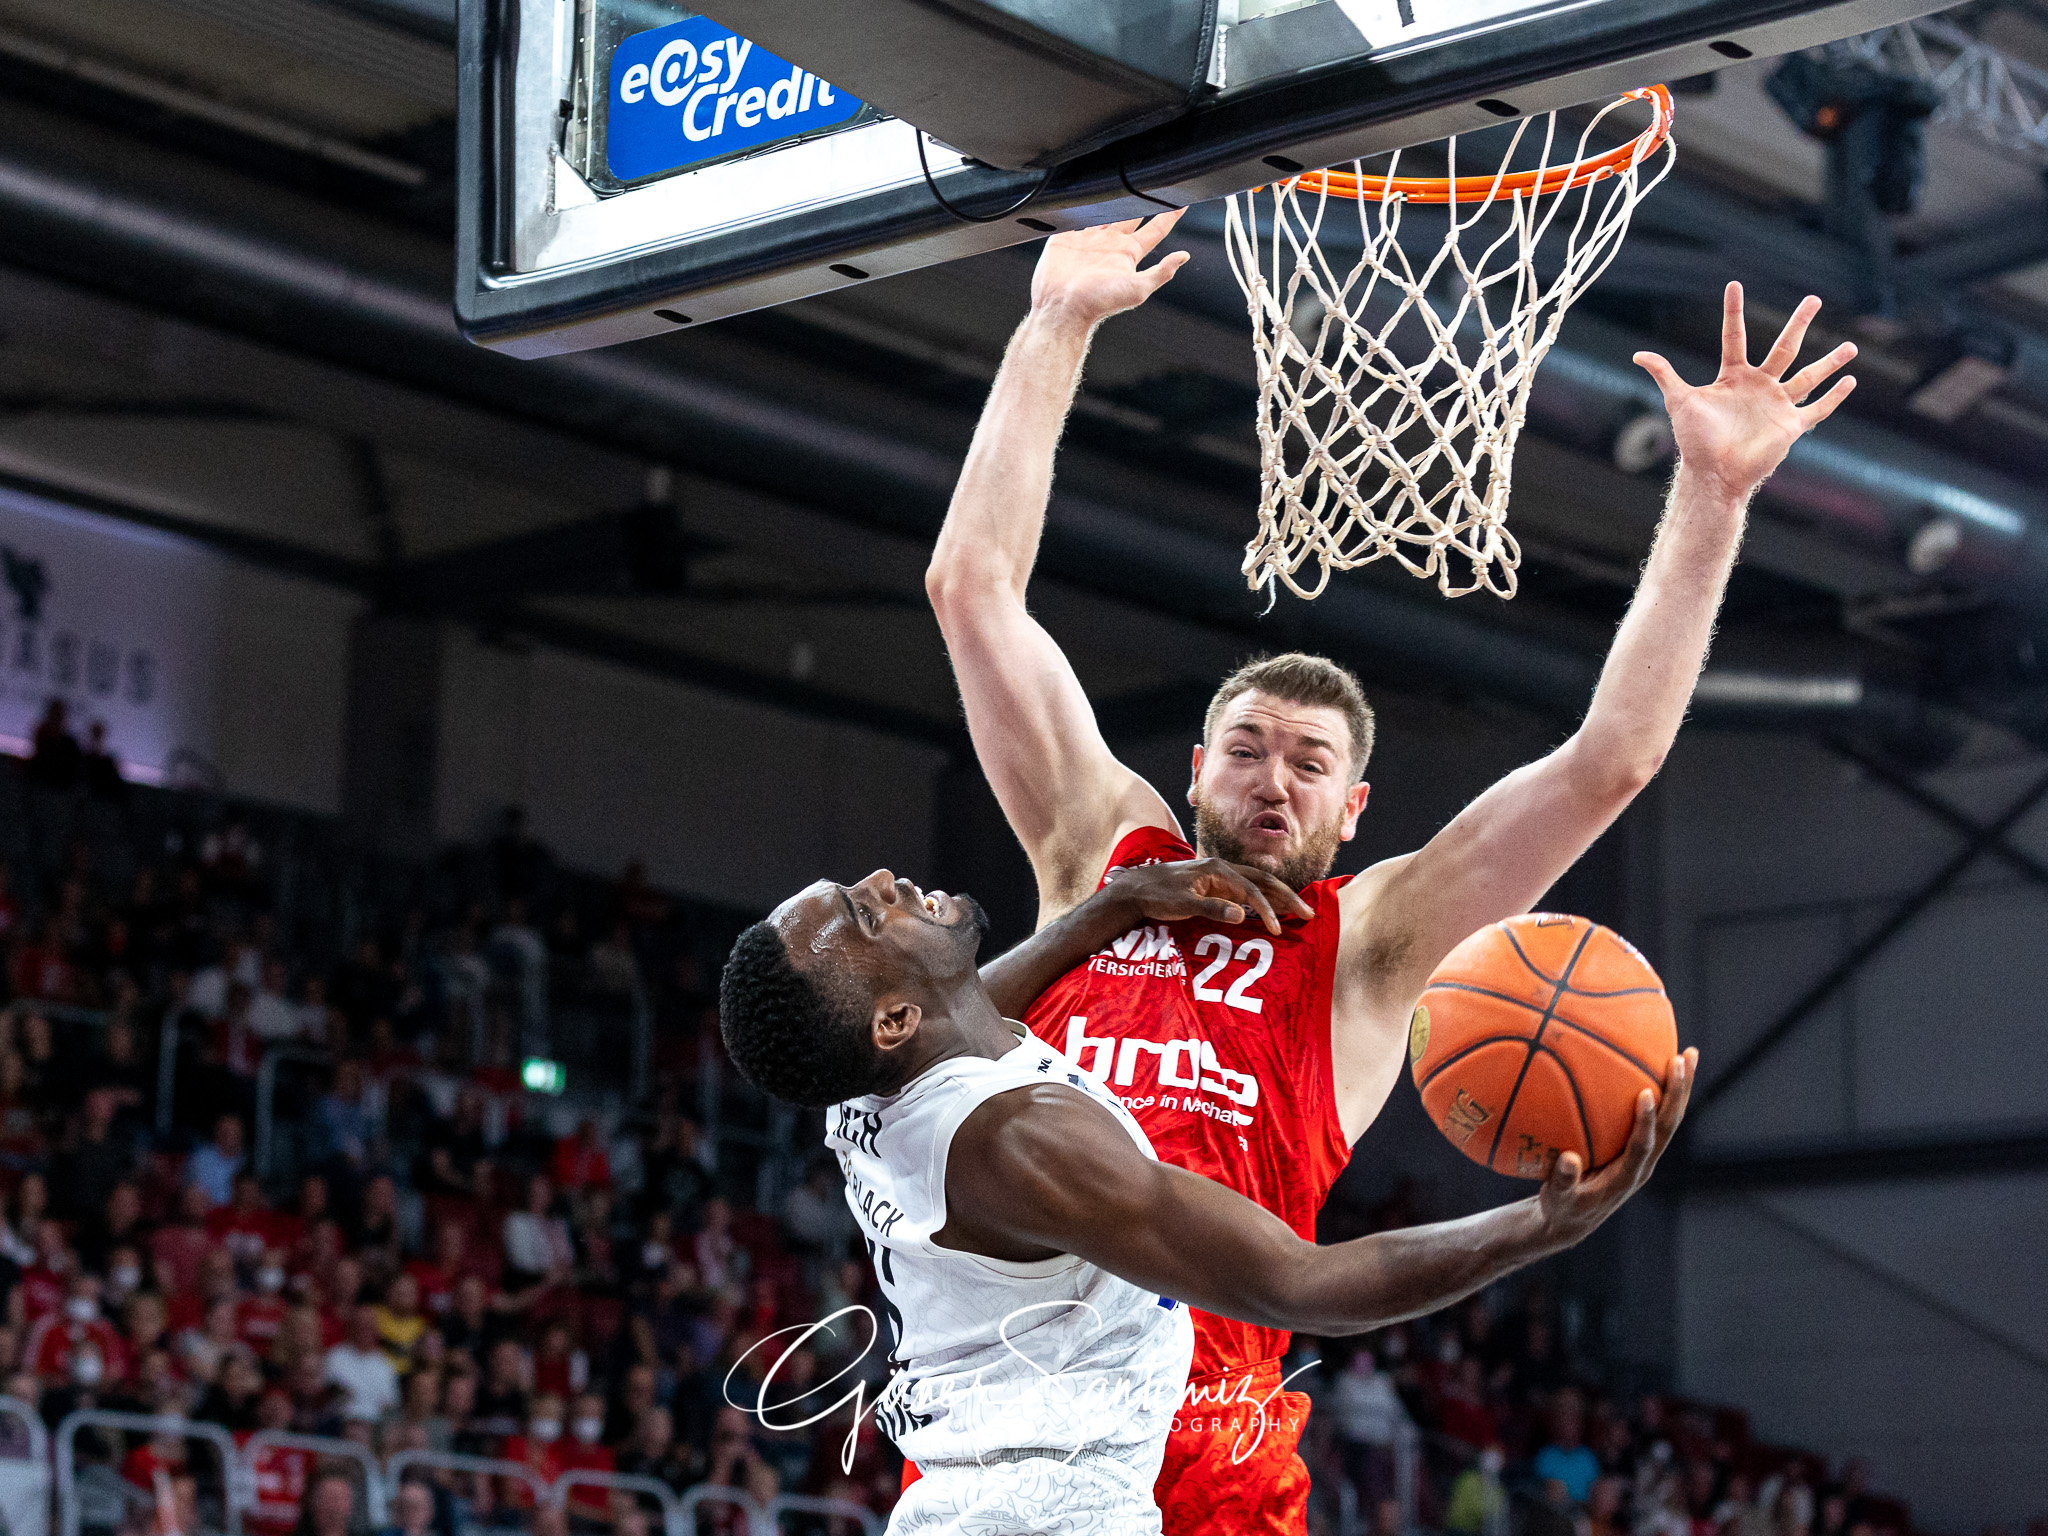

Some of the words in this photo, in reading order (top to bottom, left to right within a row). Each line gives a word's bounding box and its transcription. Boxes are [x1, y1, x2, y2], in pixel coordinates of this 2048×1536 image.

[682, 64, 835, 142] Credit
[1191, 933, 1275, 1015] 22
[1159, 1094, 1178, 1110] in
